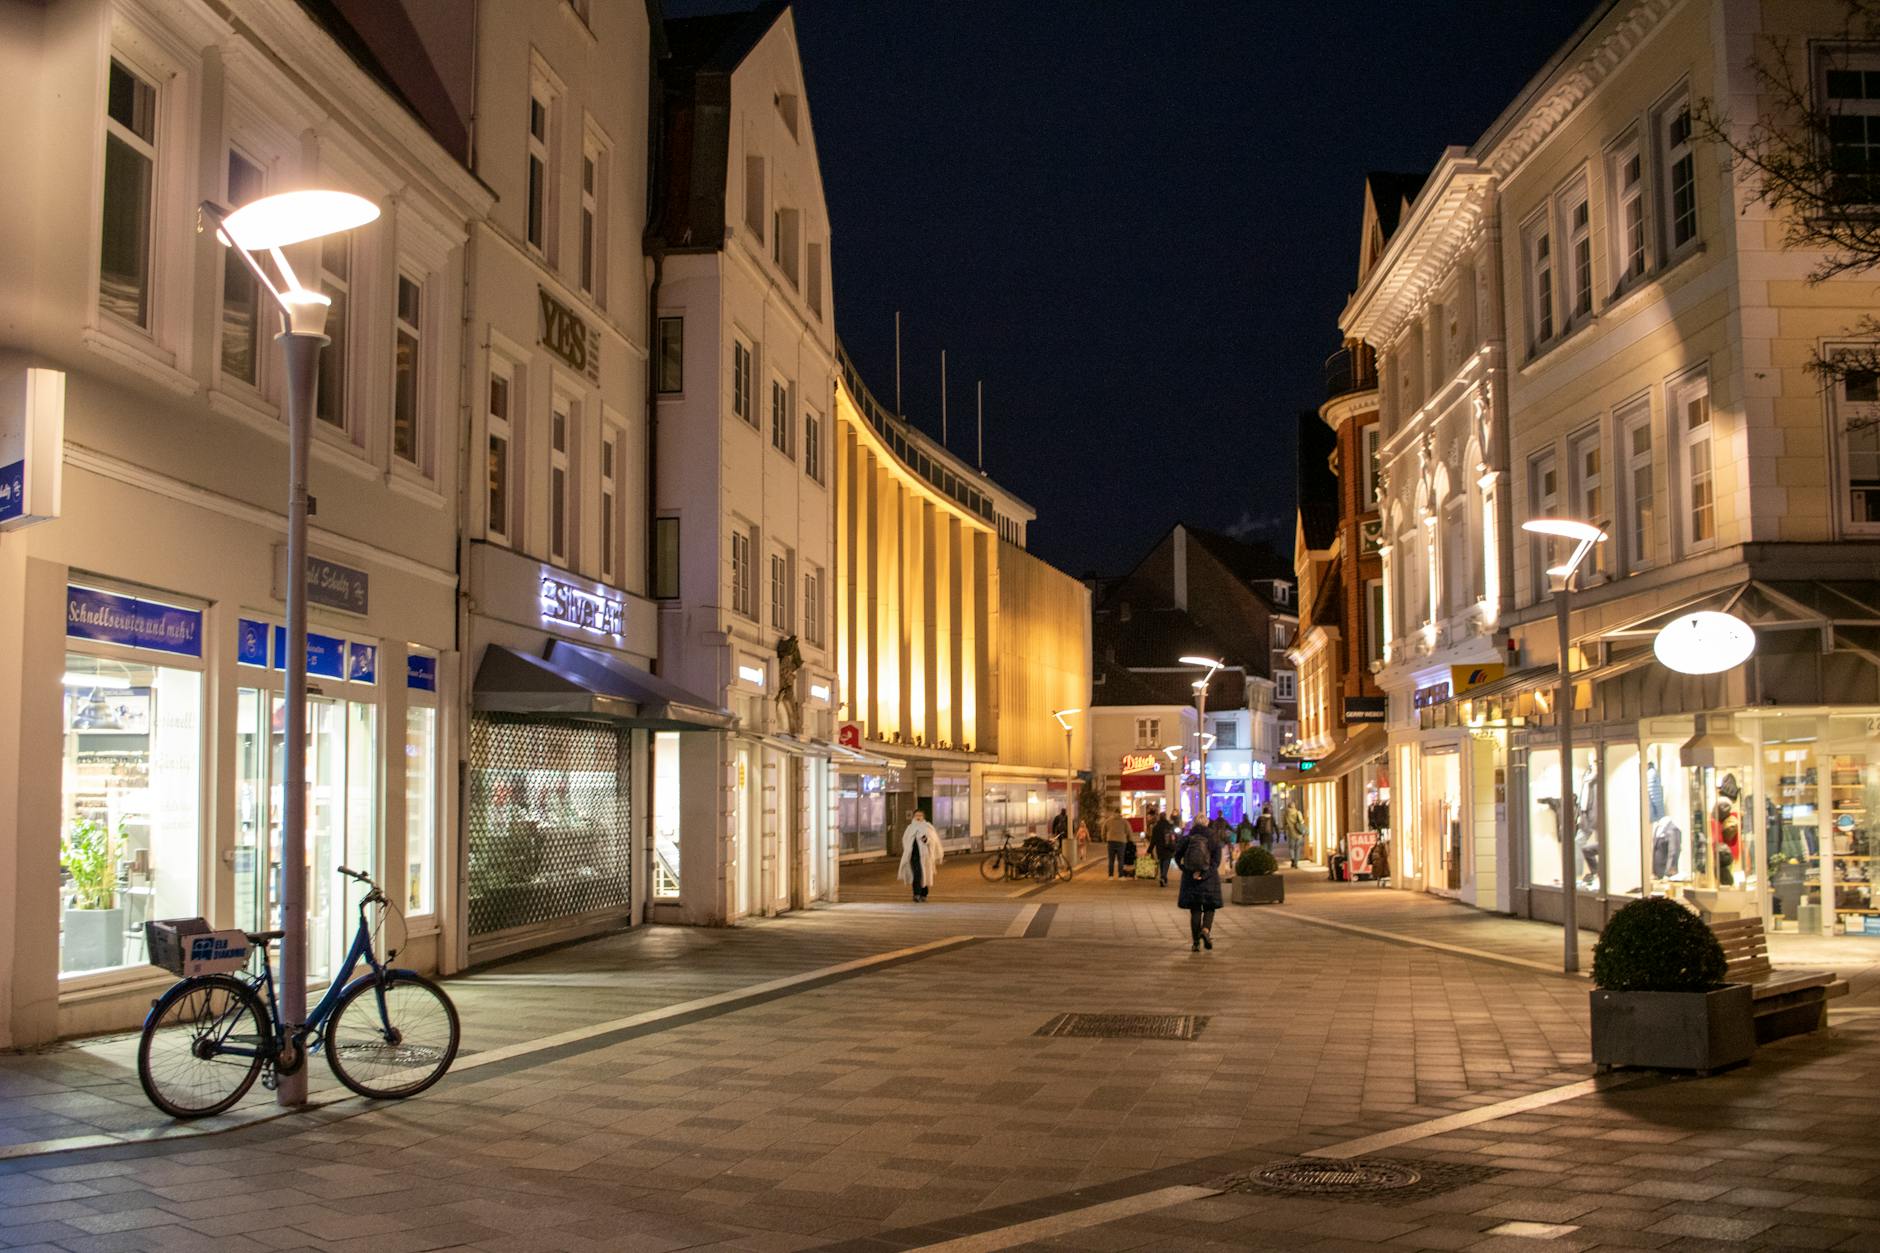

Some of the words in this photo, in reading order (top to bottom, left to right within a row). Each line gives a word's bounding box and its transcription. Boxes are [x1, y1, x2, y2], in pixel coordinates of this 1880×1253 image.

[68, 600, 145, 633] Schnellservice
[145, 616, 166, 637] und
[166, 620, 195, 640] mehr!
[1122, 755, 1156, 771] Ditsch
[1350, 833, 1377, 846] SALE
